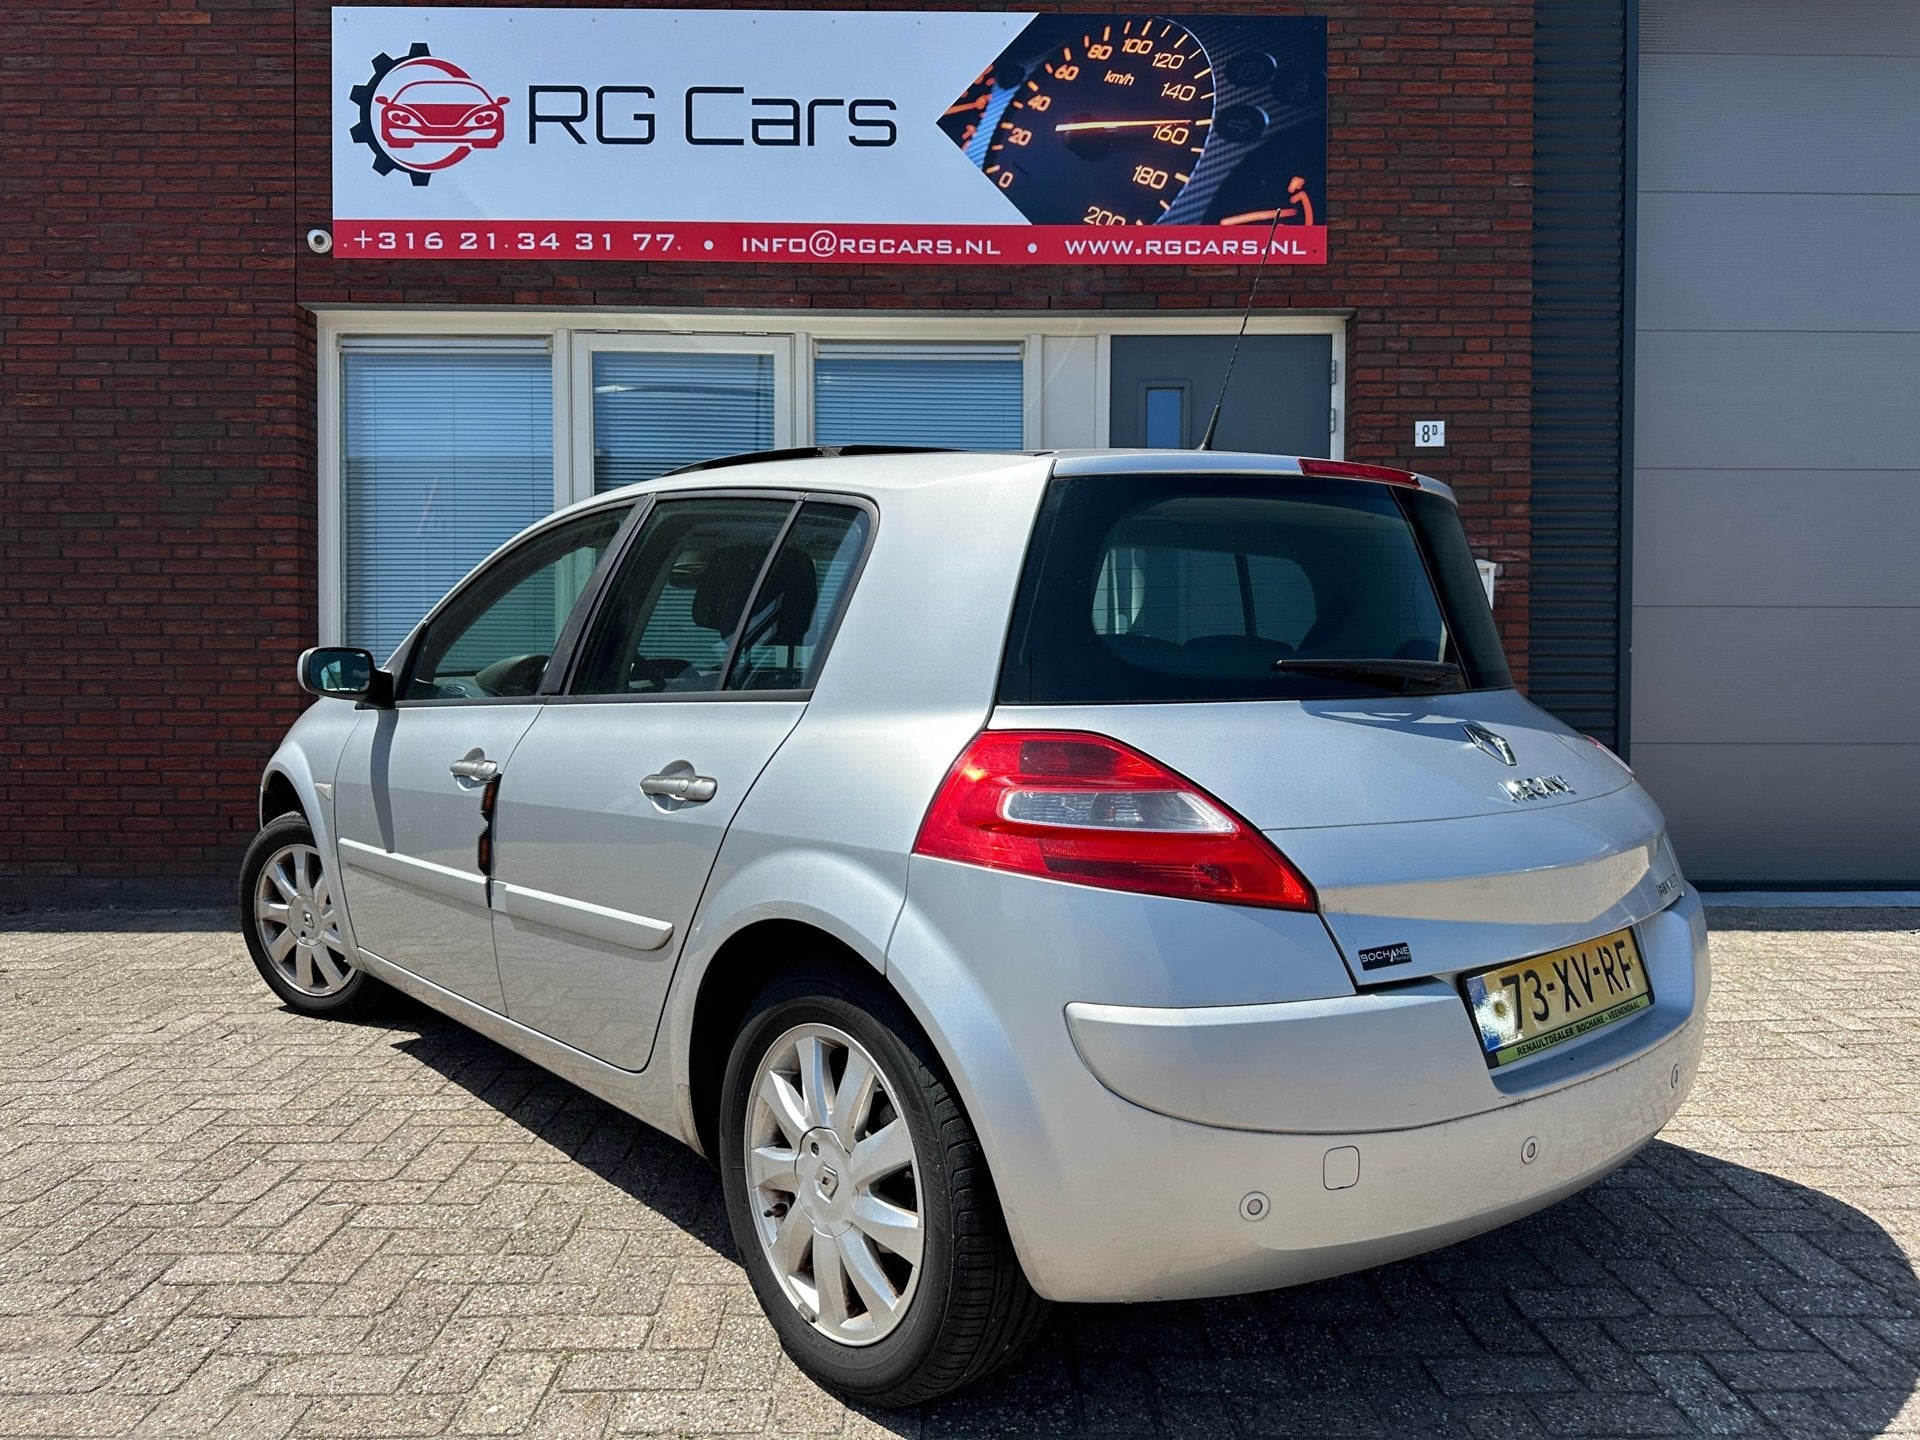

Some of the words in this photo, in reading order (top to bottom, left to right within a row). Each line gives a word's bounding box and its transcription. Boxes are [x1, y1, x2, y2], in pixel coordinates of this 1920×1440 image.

[1087, 44, 1113, 60] 80
[1122, 38, 1154, 54] 100
[1151, 52, 1185, 70] 120
[1054, 65, 1079, 81] 60
[1104, 70, 1135, 87] km/h
[1160, 83, 1196, 102] 140
[1027, 95, 1051, 112] 40
[528, 85, 656, 145] RG
[684, 86, 897, 147] Cars
[1007, 128, 1032, 146] 20
[1151, 124, 1189, 146] 160
[998, 171, 1014, 188] 0
[1132, 165, 1168, 191] 180
[575, 233, 612, 251] 31
[742, 229, 1001, 258] INFO@RGCARS.NL
[1065, 240, 1307, 255] WWW.RGCARS.NL
[1501, 940, 1631, 1031] 73-XV-RF
[1516, 1027, 1575, 1056] RENAULTDEALER
[1576, 1015, 1606, 1033] BOCHANE
[1607, 1001, 1641, 1021] VEENENDAAL
